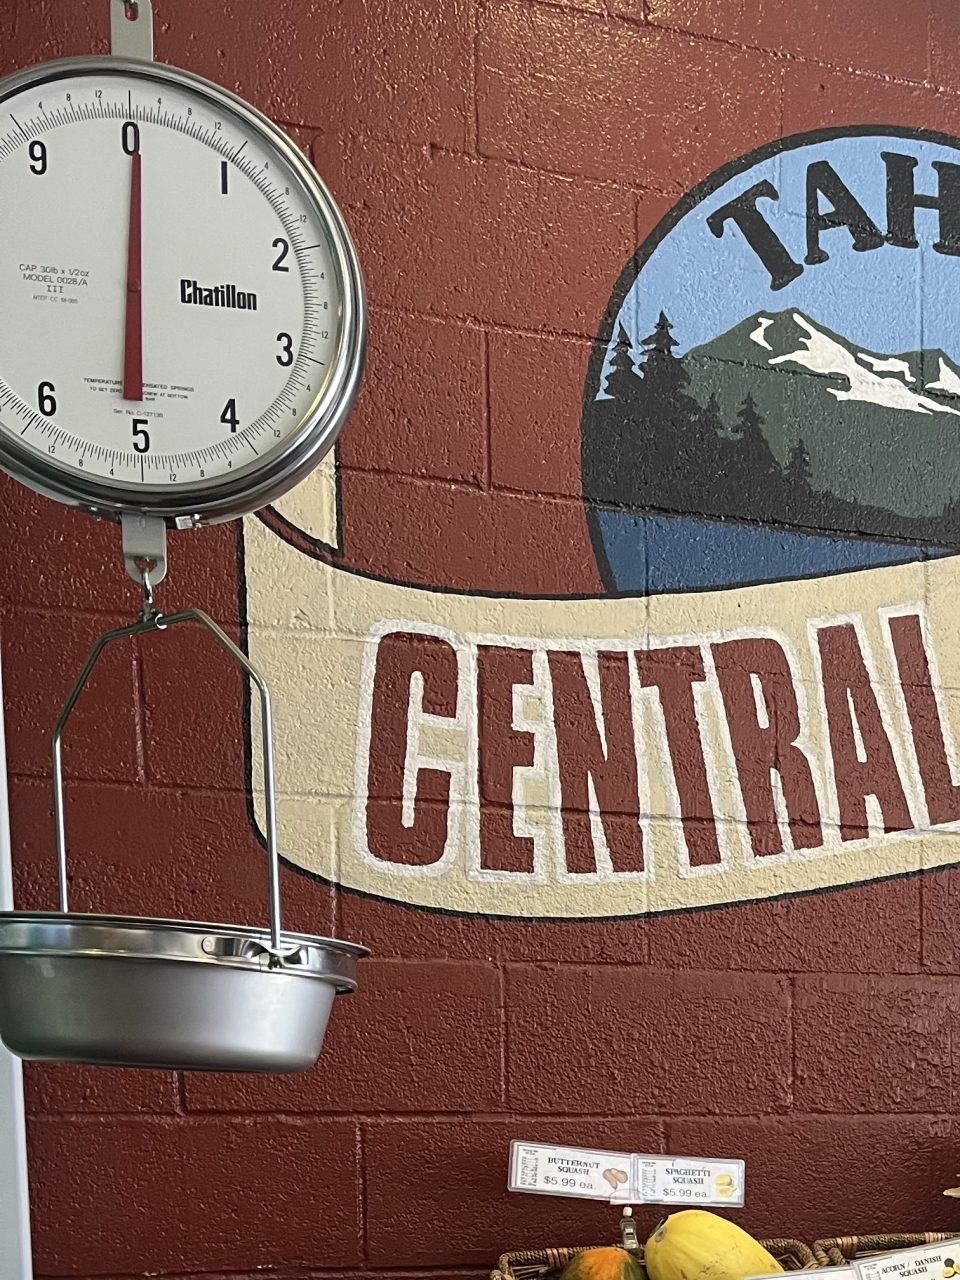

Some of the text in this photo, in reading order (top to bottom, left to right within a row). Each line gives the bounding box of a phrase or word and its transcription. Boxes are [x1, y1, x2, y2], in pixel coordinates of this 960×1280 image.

[121, 121, 140, 156] 0
[28, 140, 47, 175] 9
[221, 160, 228, 194] 1
[271, 238, 290, 272] 2
[19, 264, 37, 272] CAP
[23, 273, 54, 284] MODEL
[180, 278, 258, 311] Chatillon
[275, 332, 294, 367] 3
[37, 380, 57, 417] 6
[220, 398, 240, 433] 4
[132, 418, 150, 454] 5
[547, 1156, 600, 1169] BUTTERNUT
[558, 1166, 590, 1176] SQUASH
[544, 1175, 576, 1188] $5.99
[665, 1168, 711, 1178] SPAGHETTI
[672, 1176, 704, 1185] SQUASH
[663, 1188, 692, 1198] $5.99
[882, 1263, 906, 1274] ACORN
[914, 1254, 942, 1267] DANISH
[899, 1266, 928, 1278] SQUASH
